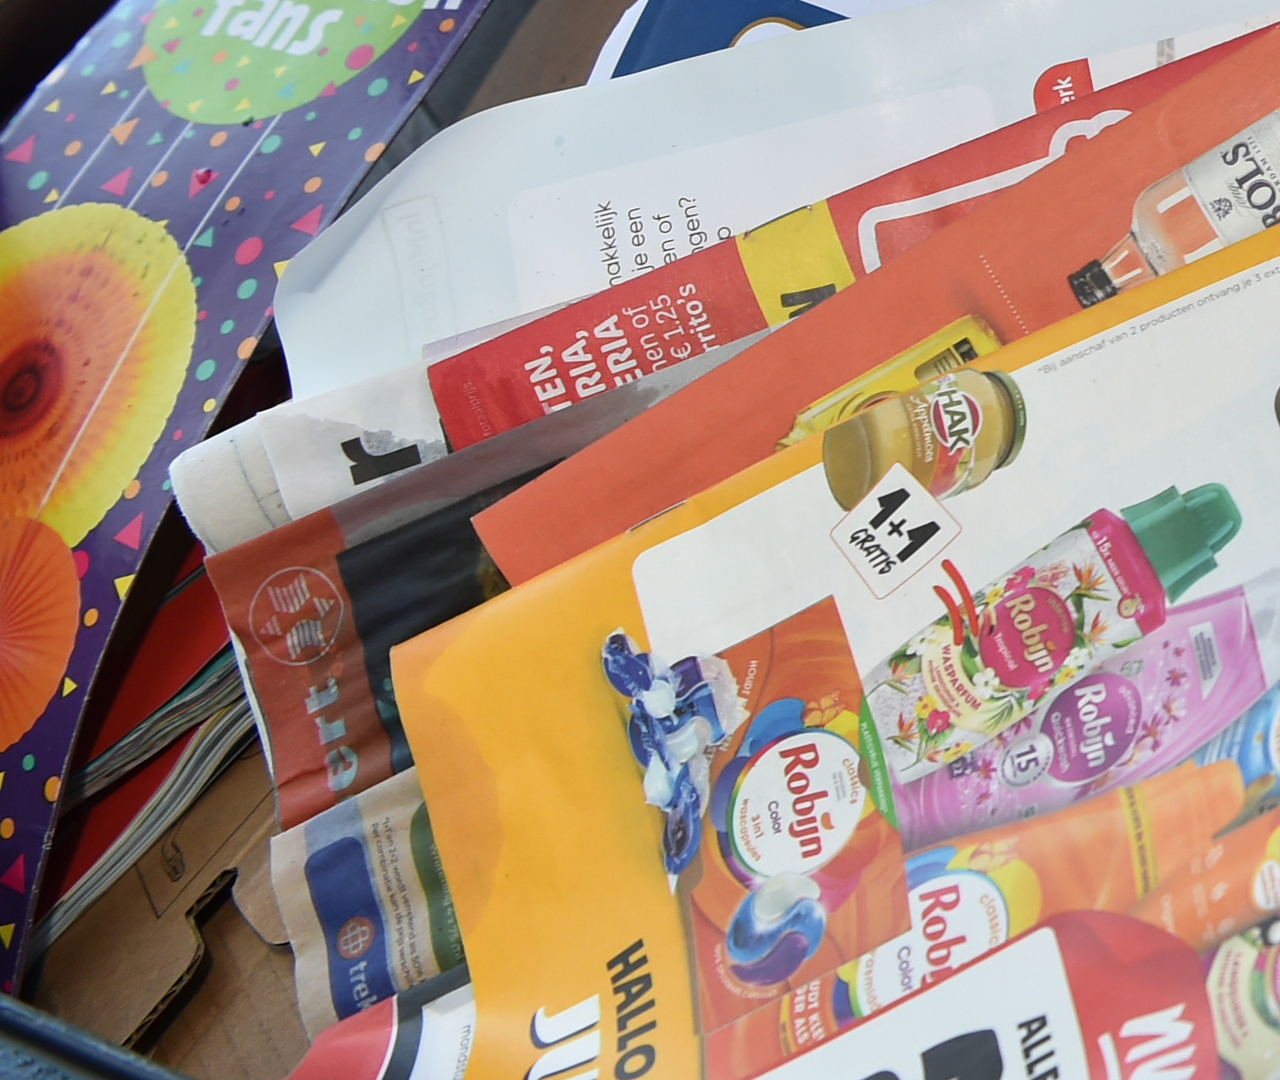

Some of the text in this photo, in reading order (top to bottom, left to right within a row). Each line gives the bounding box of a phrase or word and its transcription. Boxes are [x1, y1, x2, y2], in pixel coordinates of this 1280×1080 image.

[628, 207, 655, 273] je een
[653, 213, 673, 235] of
[623, 306, 650, 329] of
[650, 294, 692, 360] € 1.25
[1059, 340, 1106, 366] aanschaf
[1108, 333, 1128, 346] van
[1129, 325, 1138, 336] 2
[1139, 303, 1195, 331] producten
[1197, 284, 1240, 308] ontvang
[1242, 278, 1252, 292] je
[1254, 273, 1262, 283] 3
[562, 330, 608, 398] RIA,
[937, 390, 970, 450] HAK
[849, 528, 896, 575] GRATIS
[869, 488, 941, 563] 1+1
[993, 632, 1018, 671] Tropical
[1005, 594, 1055, 673] Robijn
[742, 660, 758, 696] HOUDT
[941, 645, 982, 711] WASPARFUM
[1075, 683, 1108, 767] Robijn
[842, 758, 858, 804] classics
[1014, 745, 1039, 772] 15
[768, 801, 783, 834] Color
[779, 742, 823, 859] Robijn
[370, 823, 381, 838] Per
[742, 798, 762, 862] wascapsules
[375, 839, 393, 894] combinatie
[384, 833, 394, 847] en
[393, 865, 404, 894] wordt
[401, 894, 417, 939] verrekend
[389, 894, 400, 911] kan
[394, 913, 405, 925] de
[896, 945, 914, 993] Color
[606, 938, 657, 1080] HALLO
